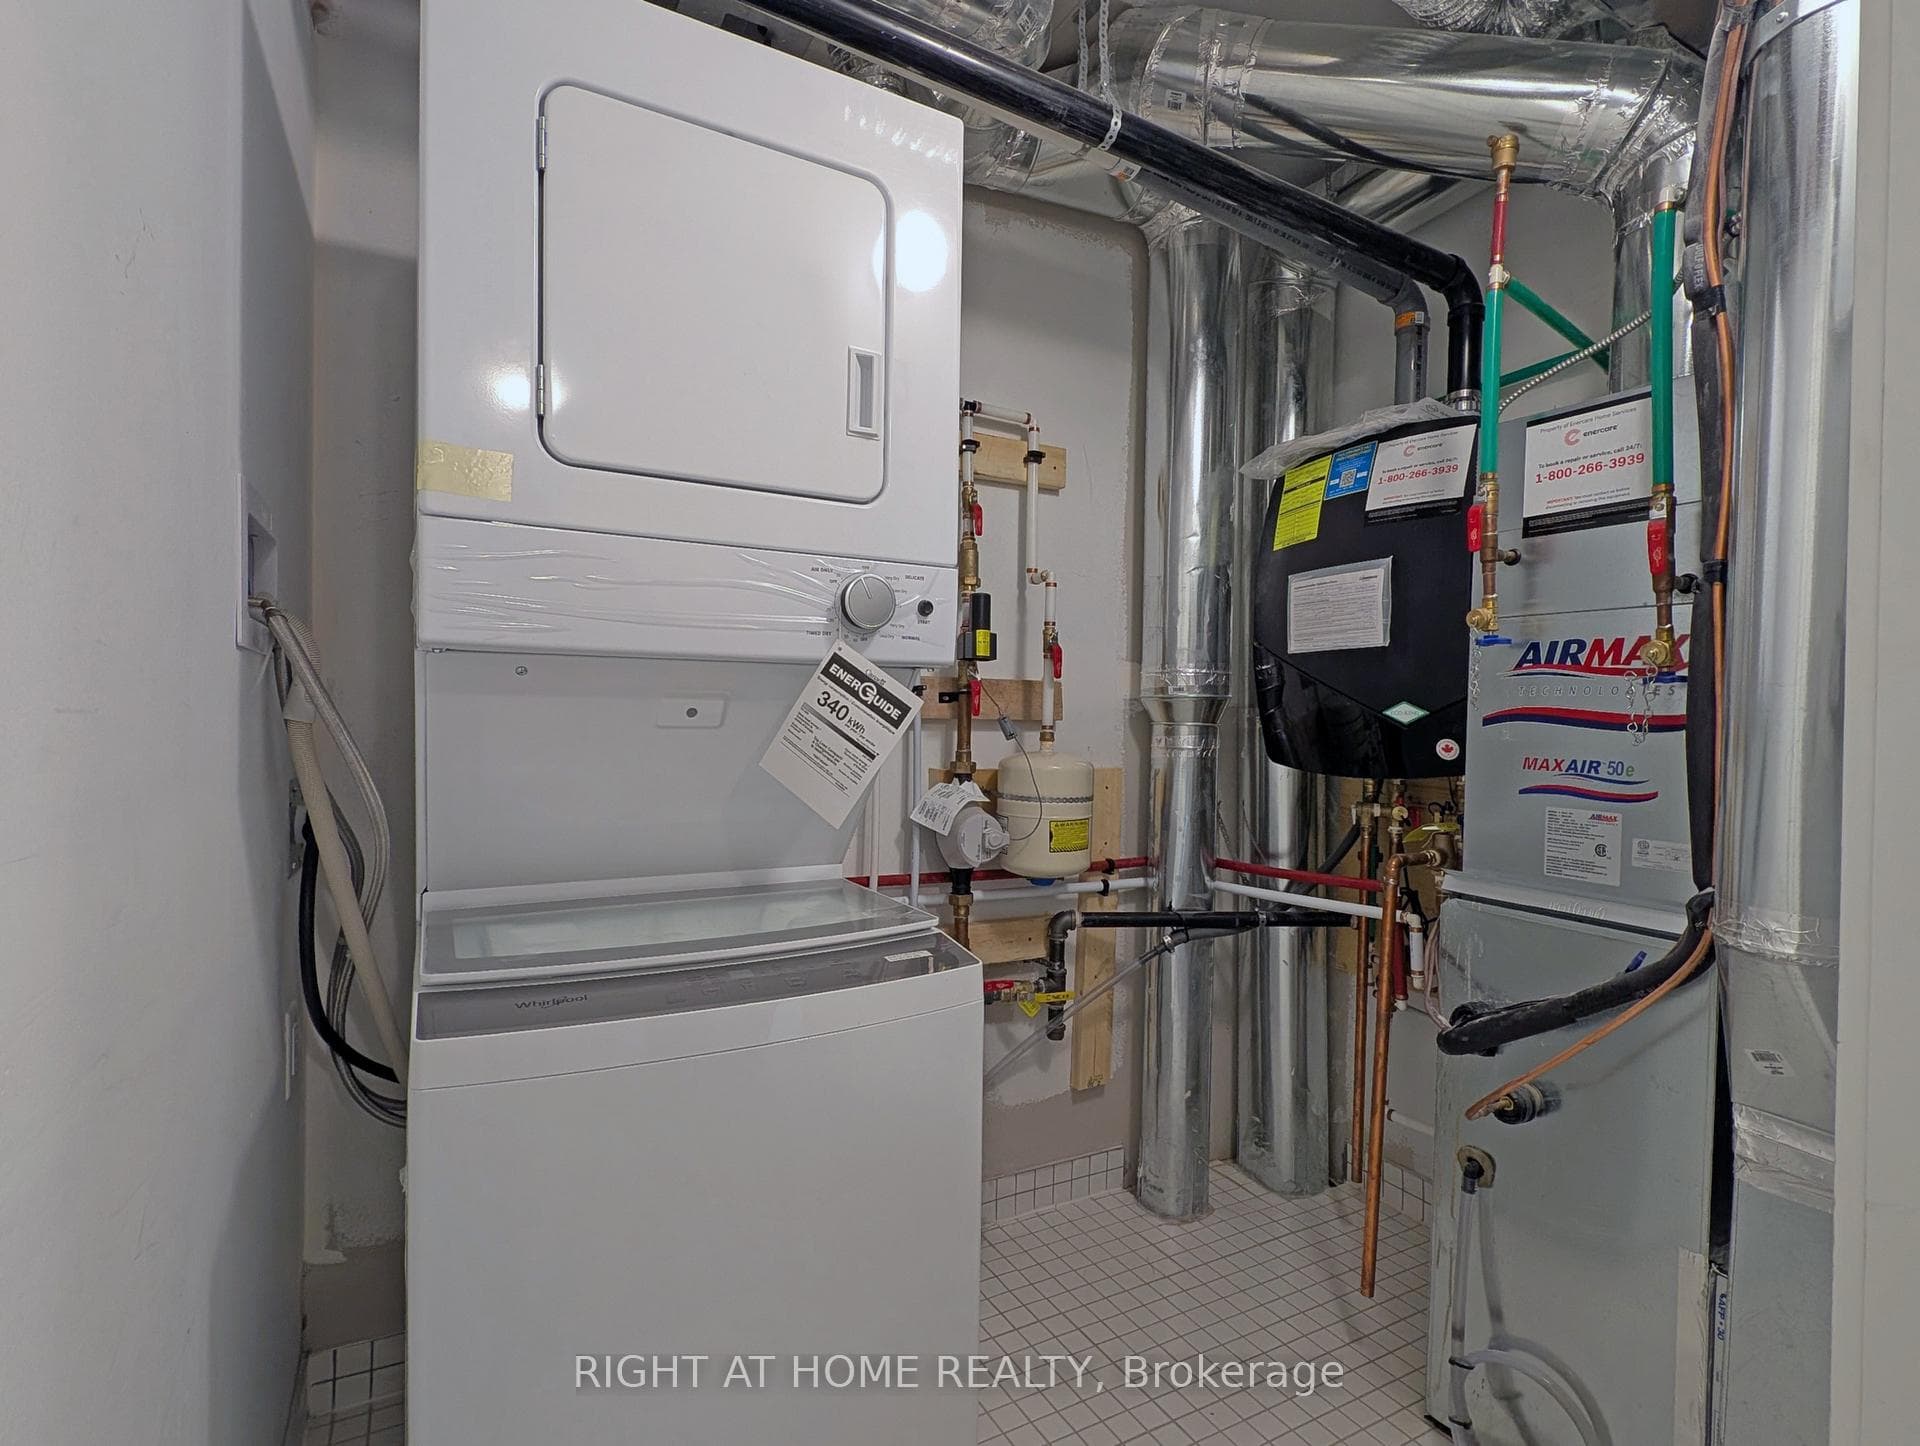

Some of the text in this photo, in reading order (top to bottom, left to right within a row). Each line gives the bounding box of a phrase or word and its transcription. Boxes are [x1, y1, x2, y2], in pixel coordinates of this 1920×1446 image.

[1378, 464, 1459, 485] 1-800-266-3939
[1535, 452, 1645, 484] 1-800-266-3939
[829, 663, 902, 720] ENERGUIDE
[817, 691, 866, 734] 340 kWh
[515, 994, 588, 1009] Whirlpool
